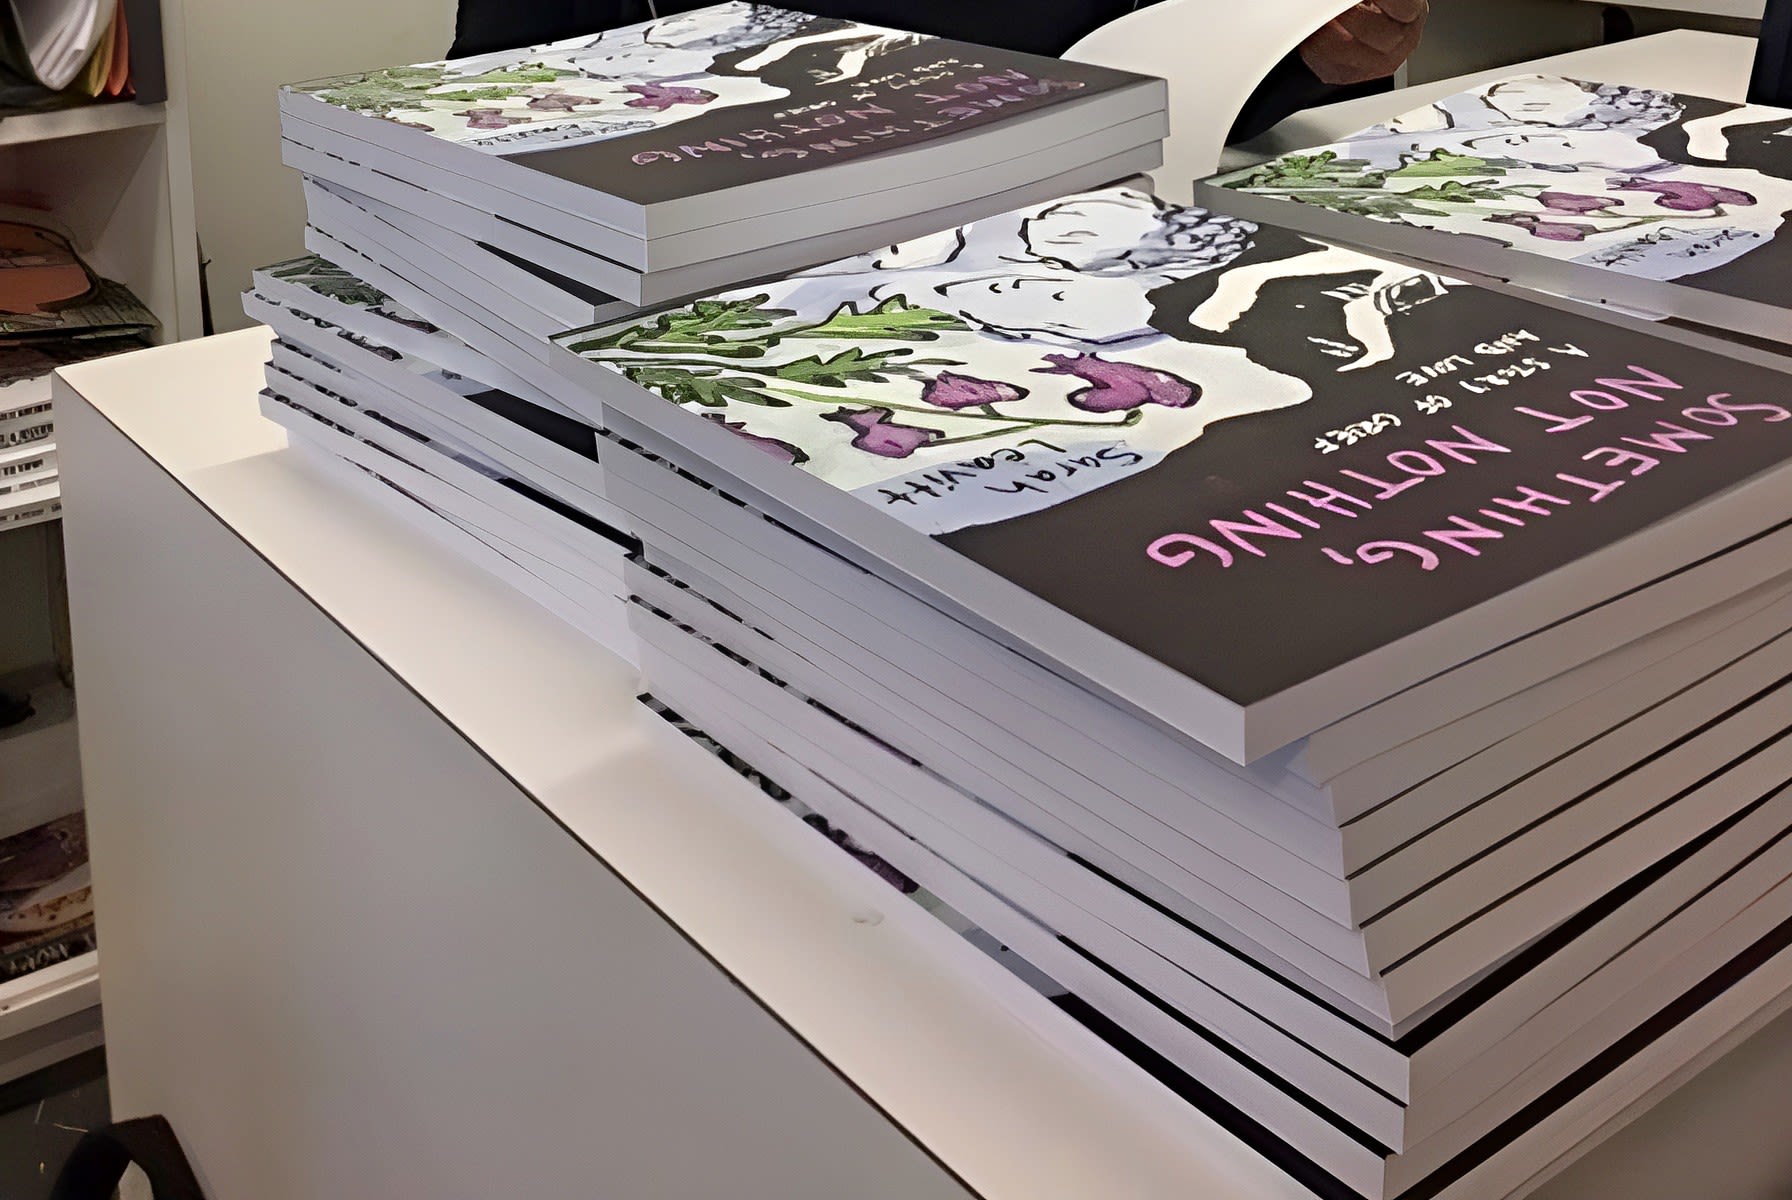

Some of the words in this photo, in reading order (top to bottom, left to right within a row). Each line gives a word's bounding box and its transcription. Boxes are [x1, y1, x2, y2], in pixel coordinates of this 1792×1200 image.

[1515, 365, 1683, 433] NOT
[877, 439, 1066, 505] Leavitt
[984, 447, 1143, 494] Sarah
[1146, 425, 1511, 567] NOTHING
[1321, 392, 1791, 571] SOMETHING,
